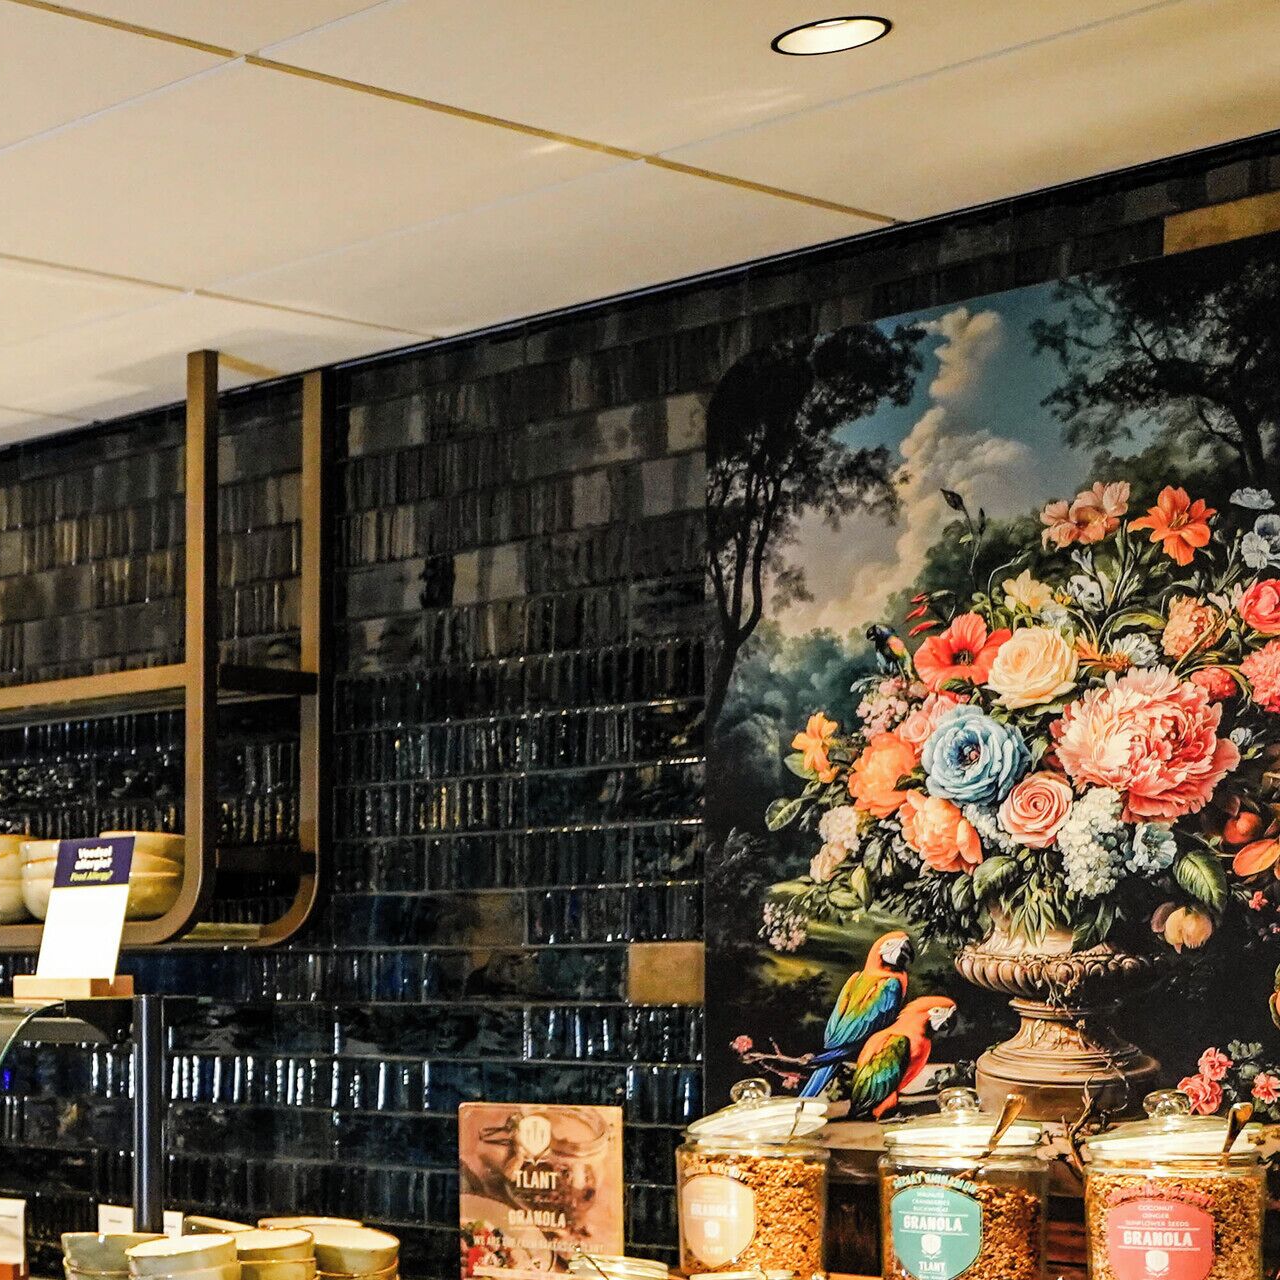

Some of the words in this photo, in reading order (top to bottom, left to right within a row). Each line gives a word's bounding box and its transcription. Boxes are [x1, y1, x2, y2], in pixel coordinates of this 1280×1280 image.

[78, 845, 113, 859] Voedsel
[514, 1171, 559, 1190] TLANT
[508, 1209, 567, 1228] GRANOLA
[903, 1215, 963, 1232] GRANOLA
[1123, 1231, 1193, 1247] GRANOLA
[919, 1261, 945, 1272] TLANT
